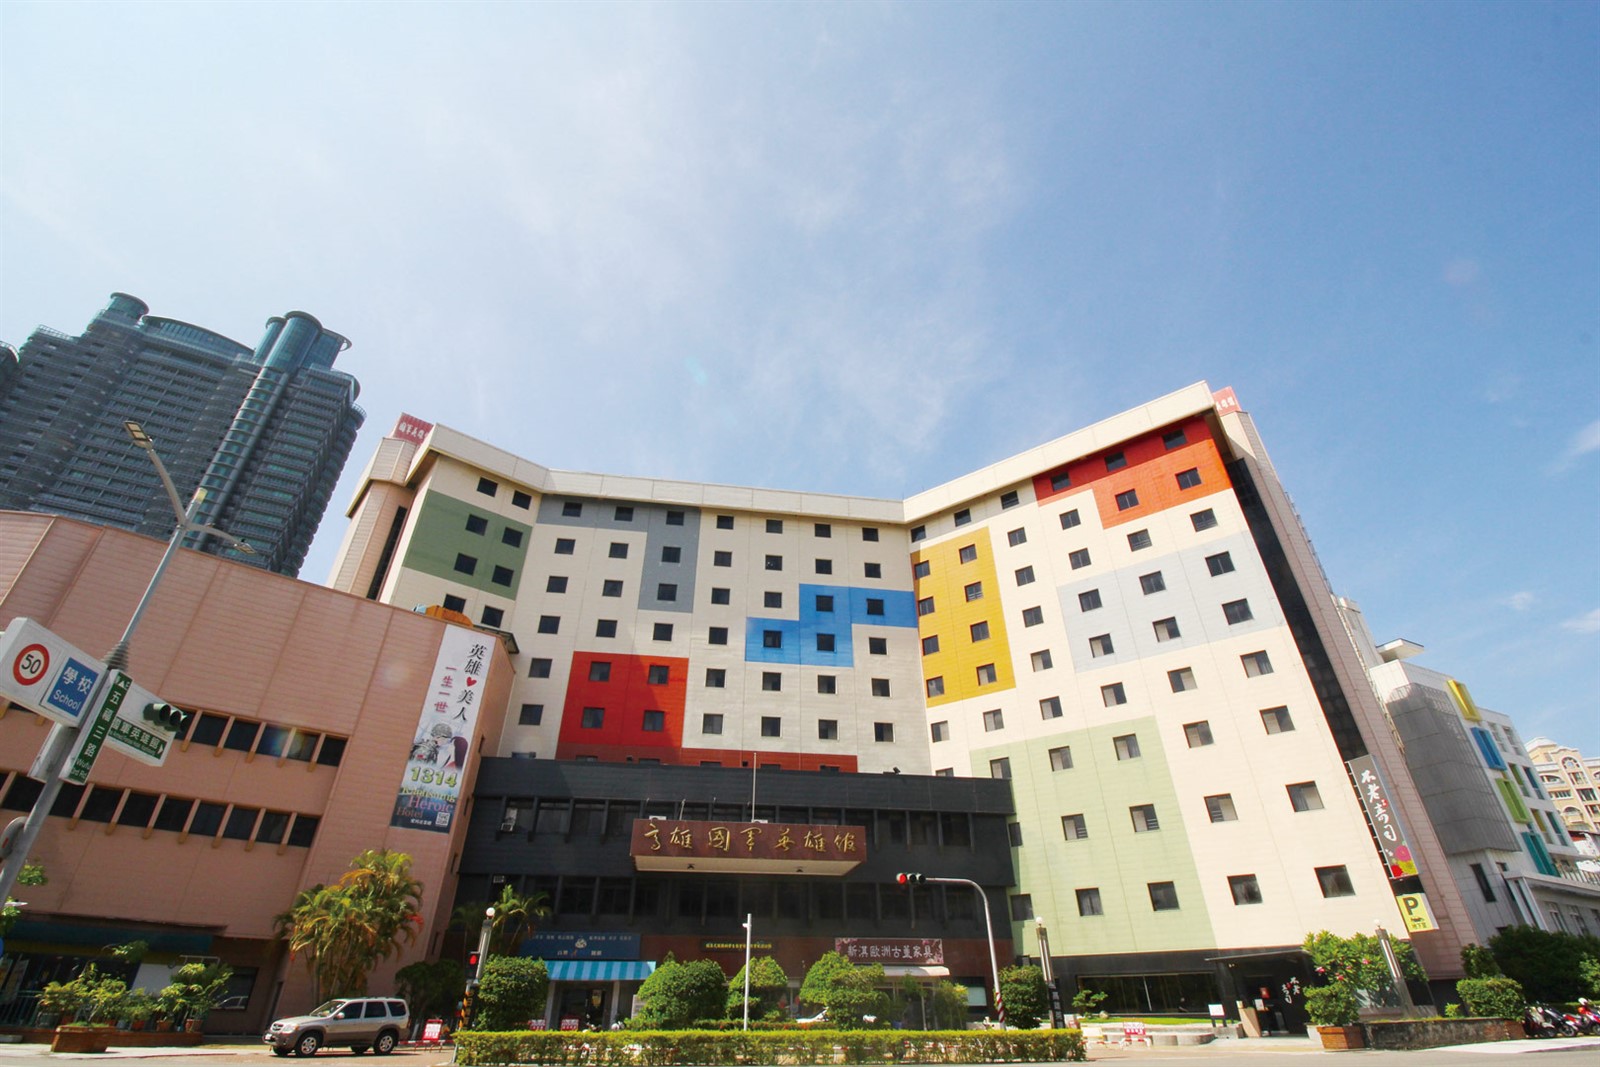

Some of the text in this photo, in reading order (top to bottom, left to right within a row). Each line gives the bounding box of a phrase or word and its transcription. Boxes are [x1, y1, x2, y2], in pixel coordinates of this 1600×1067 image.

[21, 654, 42, 674] 50
[62, 667, 93, 695] 學校
[434, 666, 458, 713] 一生一世
[53, 689, 82, 710] School
[84, 691, 122, 758] 五福三路
[411, 766, 458, 788] 1314
[408, 796, 454, 812] Heroic
[644, 823, 857, 853] 高雄國軍英雄館
[1402, 896, 1419, 916] P
